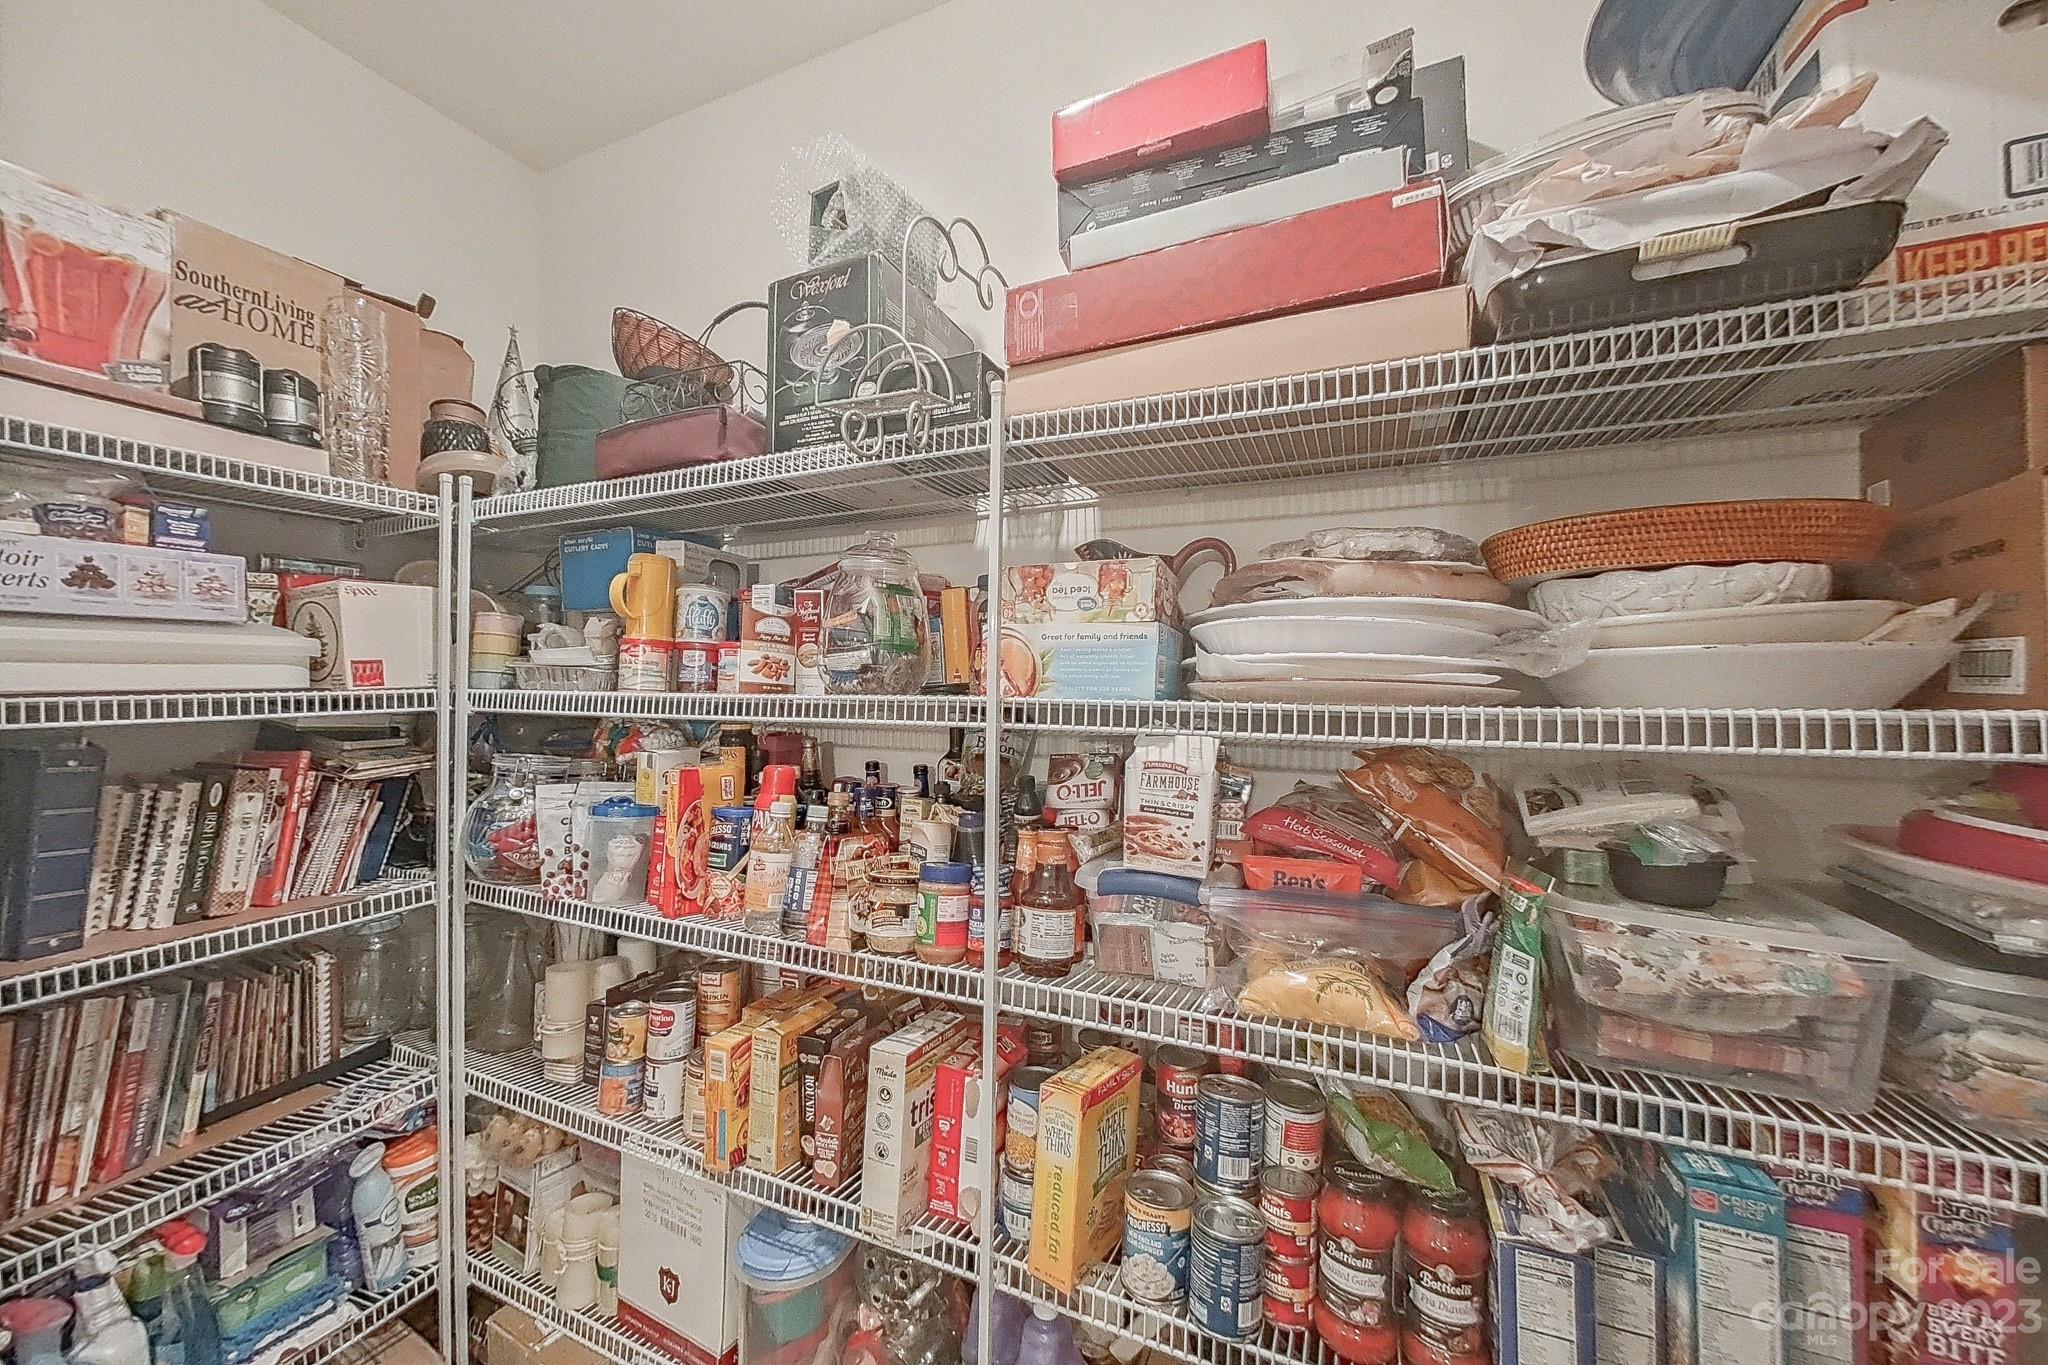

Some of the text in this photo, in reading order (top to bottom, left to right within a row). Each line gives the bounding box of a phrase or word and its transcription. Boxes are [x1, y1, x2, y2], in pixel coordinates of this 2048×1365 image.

[0, 572, 50, 589] erts
[1052, 585, 1091, 594] Iced Tea
[1041, 632, 1148, 642] Great for family and friends
[1139, 772, 1200, 792] FARMHOUSE
[1140, 798, 1160, 807] THIN
[1166, 802, 1196, 811] CRISPY
[1282, 815, 1366, 859] Herb Seasoned
[1097, 1066, 1136, 1097] FAMILY SIZE
[805, 1074, 815, 1122] ROUNDS
[1045, 1125, 1073, 1142] WHEAT
[1045, 1136, 1072, 1159] THINS
[1795, 1168, 1840, 1187] Bran
[1049, 1163, 1064, 1263] reduced fat
[1326, 1240, 1373, 1270] Botticelli
[1419, 1270, 1472, 1296] Botticelli
